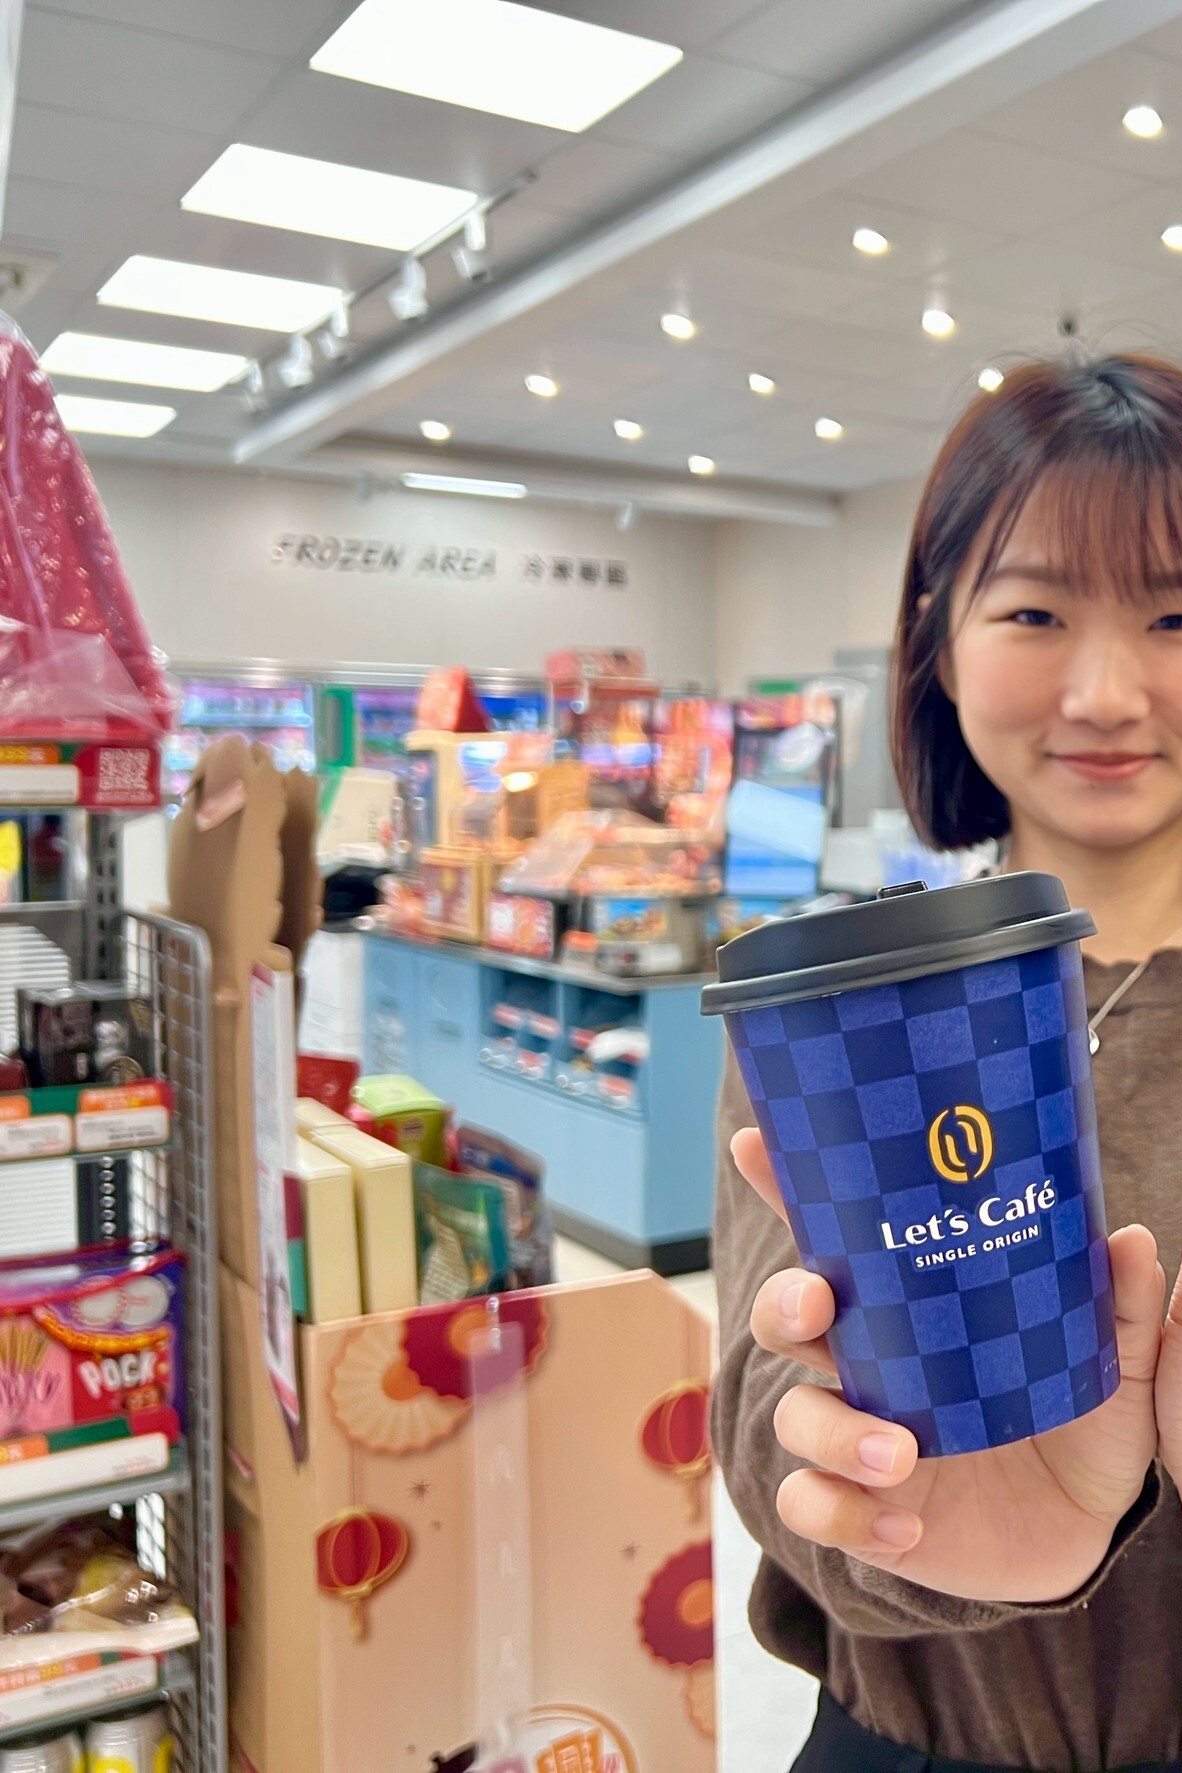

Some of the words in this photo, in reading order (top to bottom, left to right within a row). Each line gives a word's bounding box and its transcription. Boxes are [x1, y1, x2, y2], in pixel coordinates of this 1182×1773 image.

[277, 533, 402, 574] FROZEN
[416, 546, 497, 581] AREA
[880, 1209, 970, 1250] Let's
[978, 1180, 1056, 1227] Café
[915, 1244, 977, 1268] SINGLE
[982, 1224, 1040, 1253] ORIGIN
